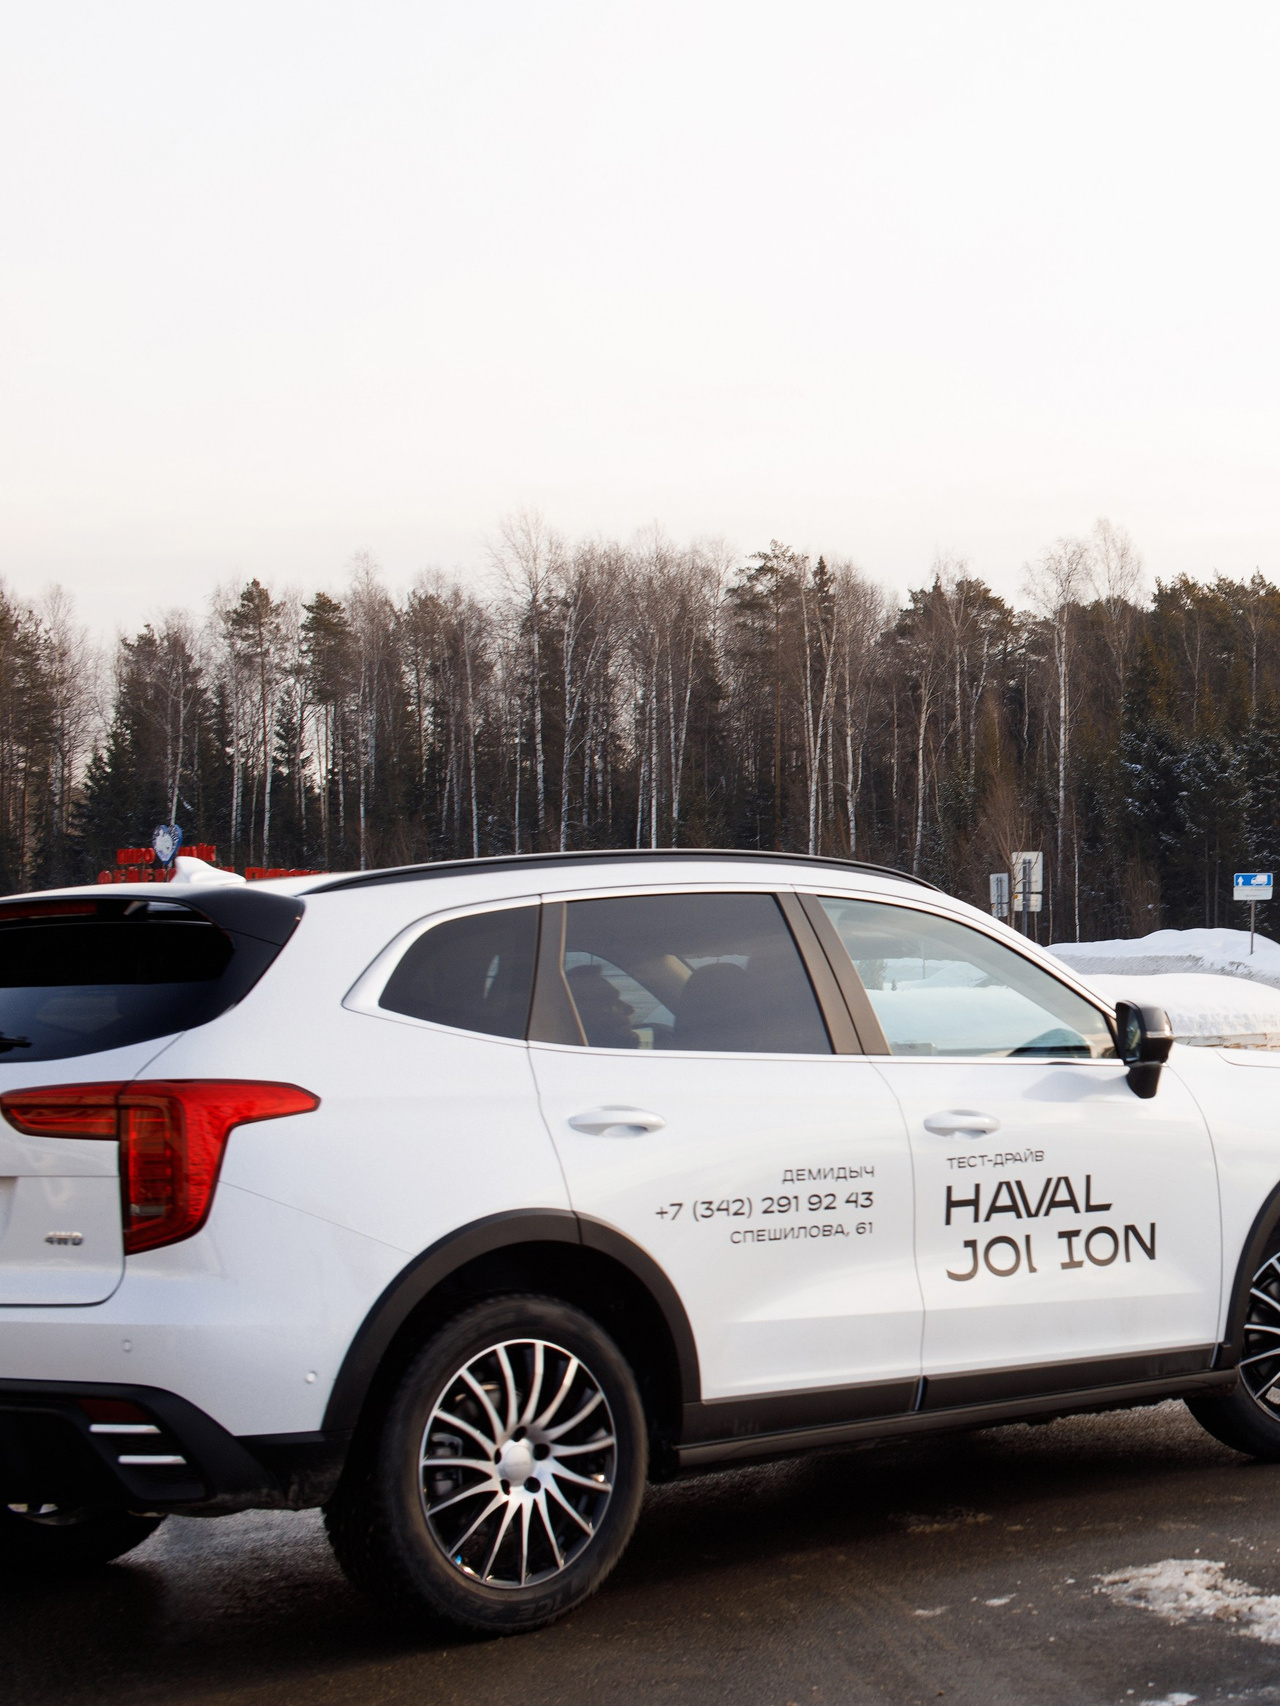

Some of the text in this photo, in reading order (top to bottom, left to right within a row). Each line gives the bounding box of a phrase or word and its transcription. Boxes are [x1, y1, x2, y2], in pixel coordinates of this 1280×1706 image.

[946, 1148, 1045, 1169] ТЕСТ-ДРАЙВ
[782, 1165, 875, 1184] ДЕМИДЫЧ
[655, 1191, 874, 1222] +7 (342) 291 92 43
[945, 1174, 1113, 1226] HAVAL
[44, 1231, 83, 1246] 4WD
[730, 1221, 874, 1244] СПЕШИЛОВА, 61
